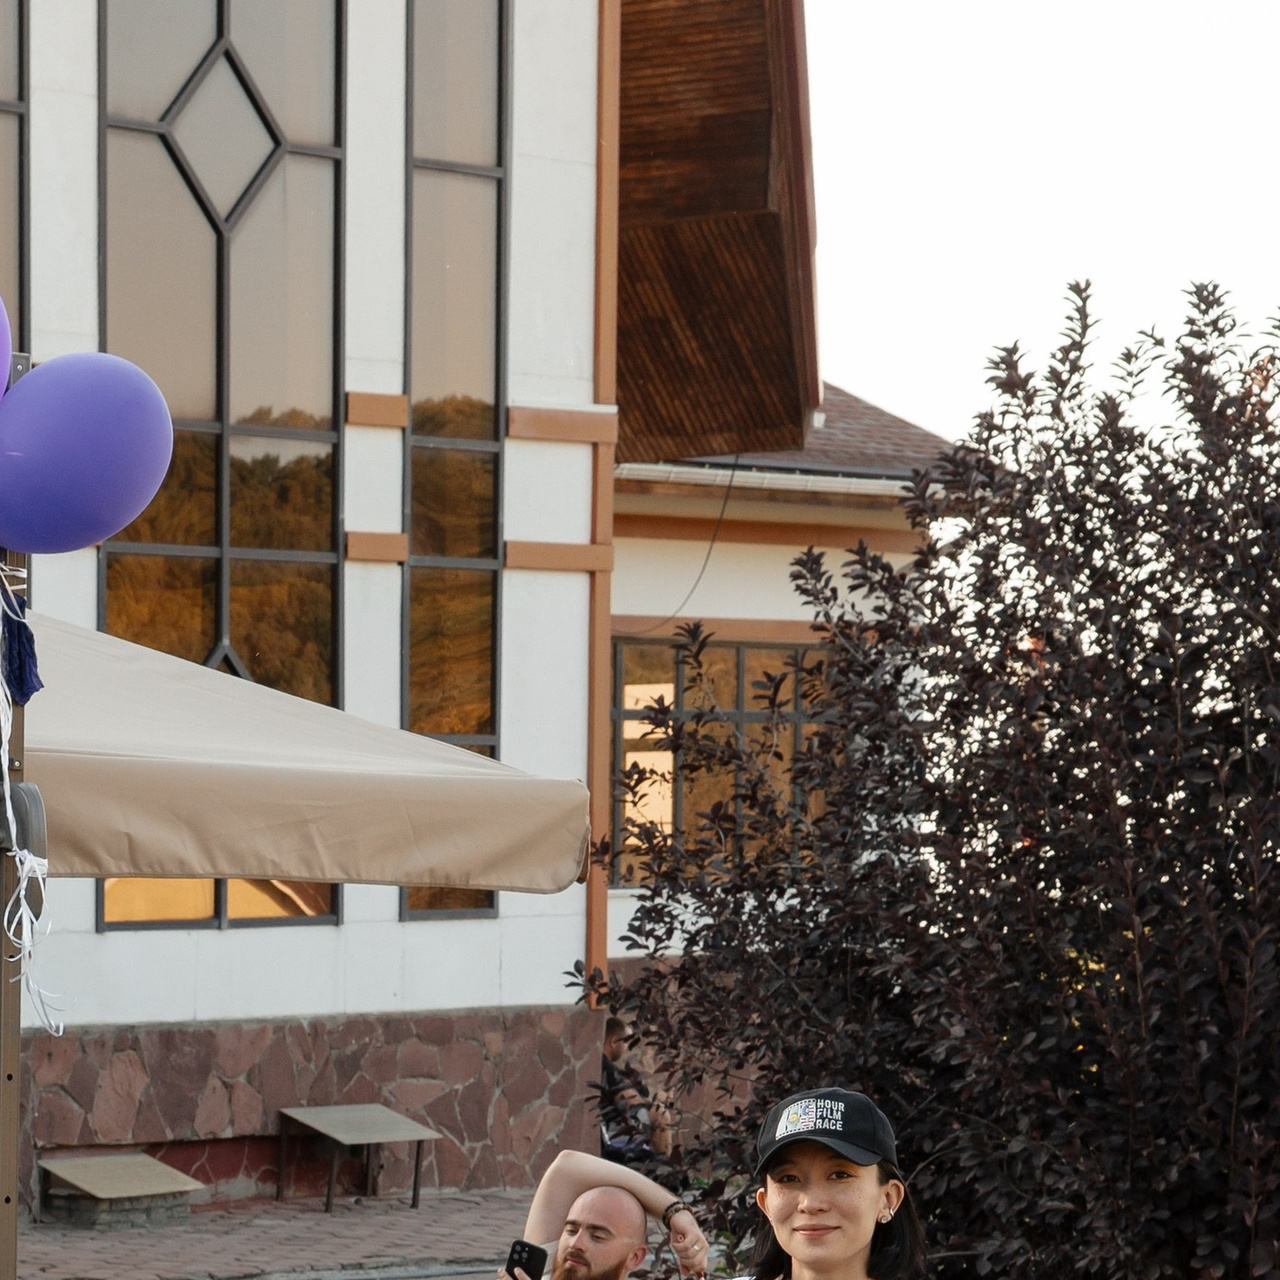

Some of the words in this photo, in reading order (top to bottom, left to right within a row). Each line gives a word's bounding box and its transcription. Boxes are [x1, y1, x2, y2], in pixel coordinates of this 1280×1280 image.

[816, 1098, 845, 1112] HOUR
[816, 1108, 841, 1120] FILM
[815, 1119, 843, 1131] RACE
